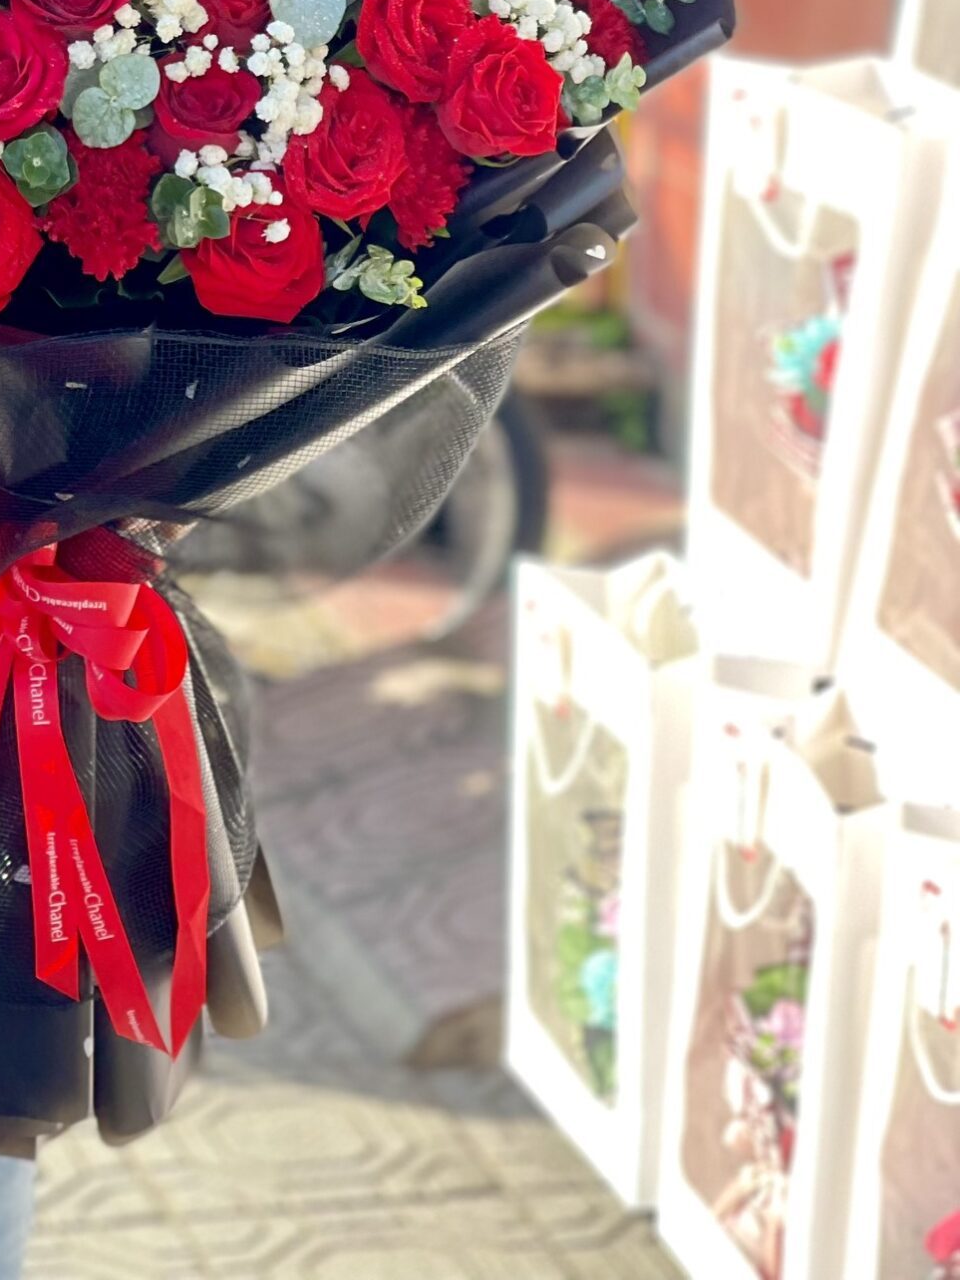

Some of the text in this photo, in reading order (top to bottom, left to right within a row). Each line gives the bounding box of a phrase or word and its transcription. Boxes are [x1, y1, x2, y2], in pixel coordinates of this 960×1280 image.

[28, 662, 52, 726] Chanel
[47, 889, 69, 943] Chanel
[83, 892, 116, 942] Chanel
